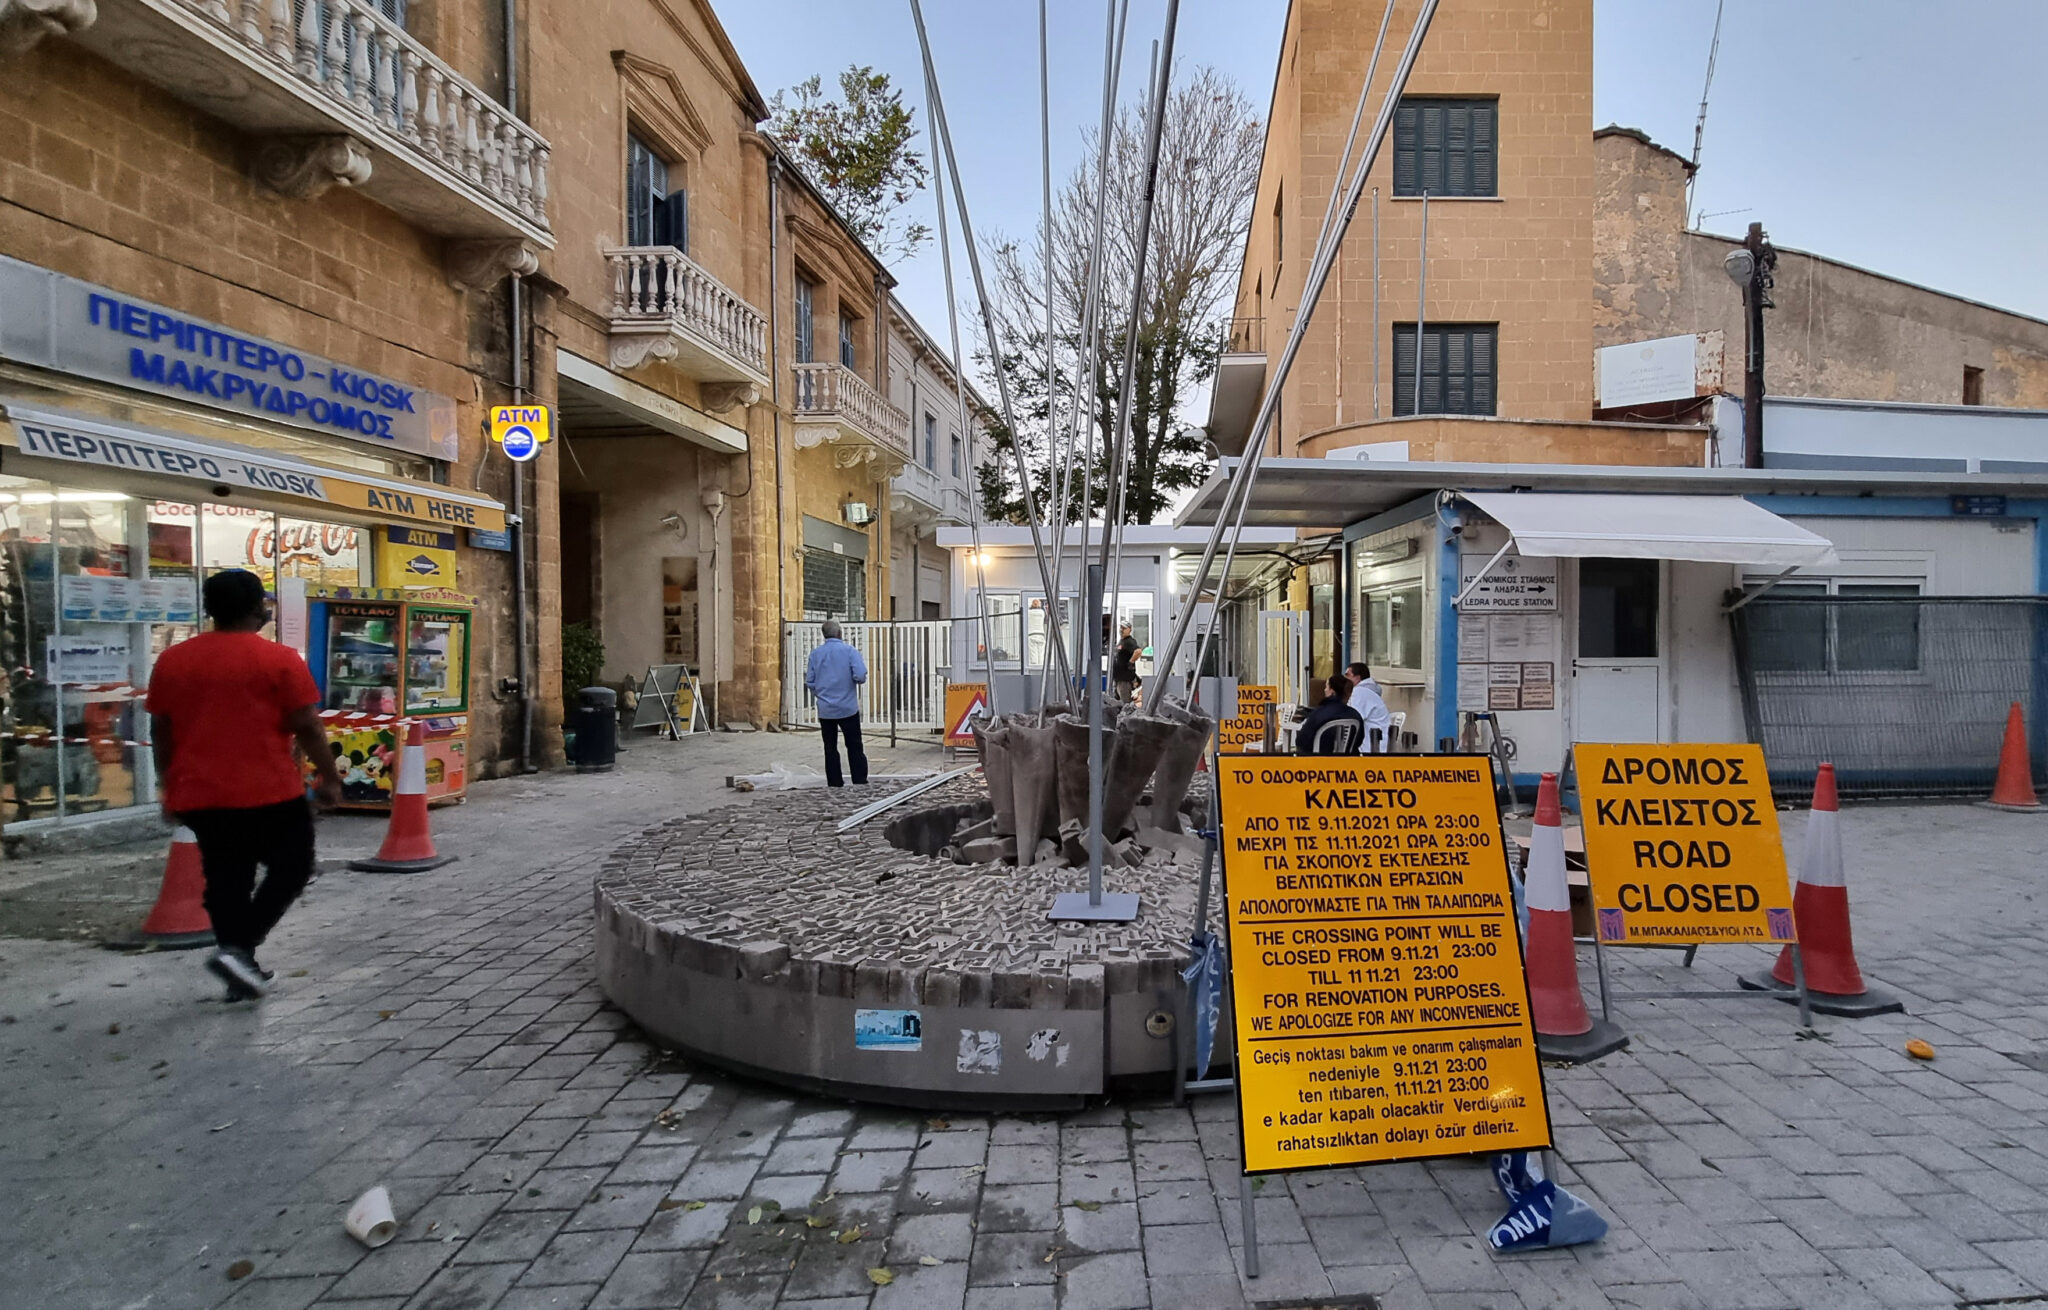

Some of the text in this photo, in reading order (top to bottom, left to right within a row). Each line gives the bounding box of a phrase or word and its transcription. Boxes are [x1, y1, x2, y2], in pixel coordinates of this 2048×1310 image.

[89, 293, 305, 382] ΠΕΡΙΠΤΕΡΟ
[331, 368, 416, 414] KIOSK
[130, 348, 395, 440] ΜΑΚΡΥΔΡΟΜΟΣ
[497, 409, 541, 423] ATM
[22, 425, 222, 479] ΠΕΡΙΠΤΕΡΟ
[242, 464, 322, 499] KIOSK
[367, 489, 476, 526] ATM HERE
[407, 530, 438, 546] ATM
[1464, 576, 1555, 584] ΑΣΝΟΜΙΚΟΣ ΣΤΑΘΜΟΣ
[334, 606, 397, 617] TOYLAND
[1465, 598, 1553, 606] LEDRA POLICE STATION
[415, 612, 460, 622] TOYLAND
[1224, 719, 1263, 729] ROAD
[1232, 769, 1480, 784] ΤΟ ΟΔΟΦΡΑΓΜΑ ΘΑ ΠΑΡΑΜΕΙΝΕΙ
[1602, 758, 1748, 785] ΔΡΟΜΟΣ
[1304, 788, 1416, 809] ΚΛΕΙΣΤΟ
[1245, 814, 1479, 831] ΑΠΟ ΤΙΣ 9.11.2021 ΩΡΑ 23:00
[1596, 798, 1761, 826] ΚΛΕΙΣΤΟΣ
[1237, 832, 1490, 851] ΜΕΧΡΙ ΤΙΣ 11.11.2021 ΩΡΑ 23:00
[1264, 851, 1470, 870] ΓΙΑ ΣΚΟΠΟΥΣ ΕΚΤΕΛΕΣΗΣ
[1633, 840, 1731, 868] ROAD
[1276, 870, 1463, 889] ΒΕΛΤΙΩΤΙΚΩΝ ΕΡΓΑΣΙΩΝ
[1239, 893, 1503, 914] ΑΠΟΛΟΓΟΥΜΑΣΤΕ ΓΙΑ ΤΗΝ ΤΑΛΑΙΠΩΡΙΑ
[1618, 884, 1760, 912] CLOSED
[1252, 923, 1502, 945] THE CROSSING POINT WILL BE
[1262, 941, 1496, 966] CLOSED FROM 9.11.21 23:00
[1307, 970, 1342, 985] TILL
[1413, 964, 1458, 980] 23:00
[1263, 982, 1505, 1008] FOR RENOVATION PURPOSES.
[1251, 1002, 1520, 1030] WE APOLOGIZE FOR ANY INCONVENIENCE
[1253, 1049, 1290, 1065] Geçiş
[1392, 1045, 1406, 1055] ve
[1309, 1056, 1487, 1082] nedeniyle 9.11.21 23:00
[1298, 1089, 1322, 1102] ten
[1394, 1079, 1442, 1096] 11.11.21
[1447, 1075, 1489, 1092] 23:00
[1263, 1116, 1272, 1127] e
[1279, 1109, 1322, 1125] kadar
[1435, 1124, 1466, 1138] özür
